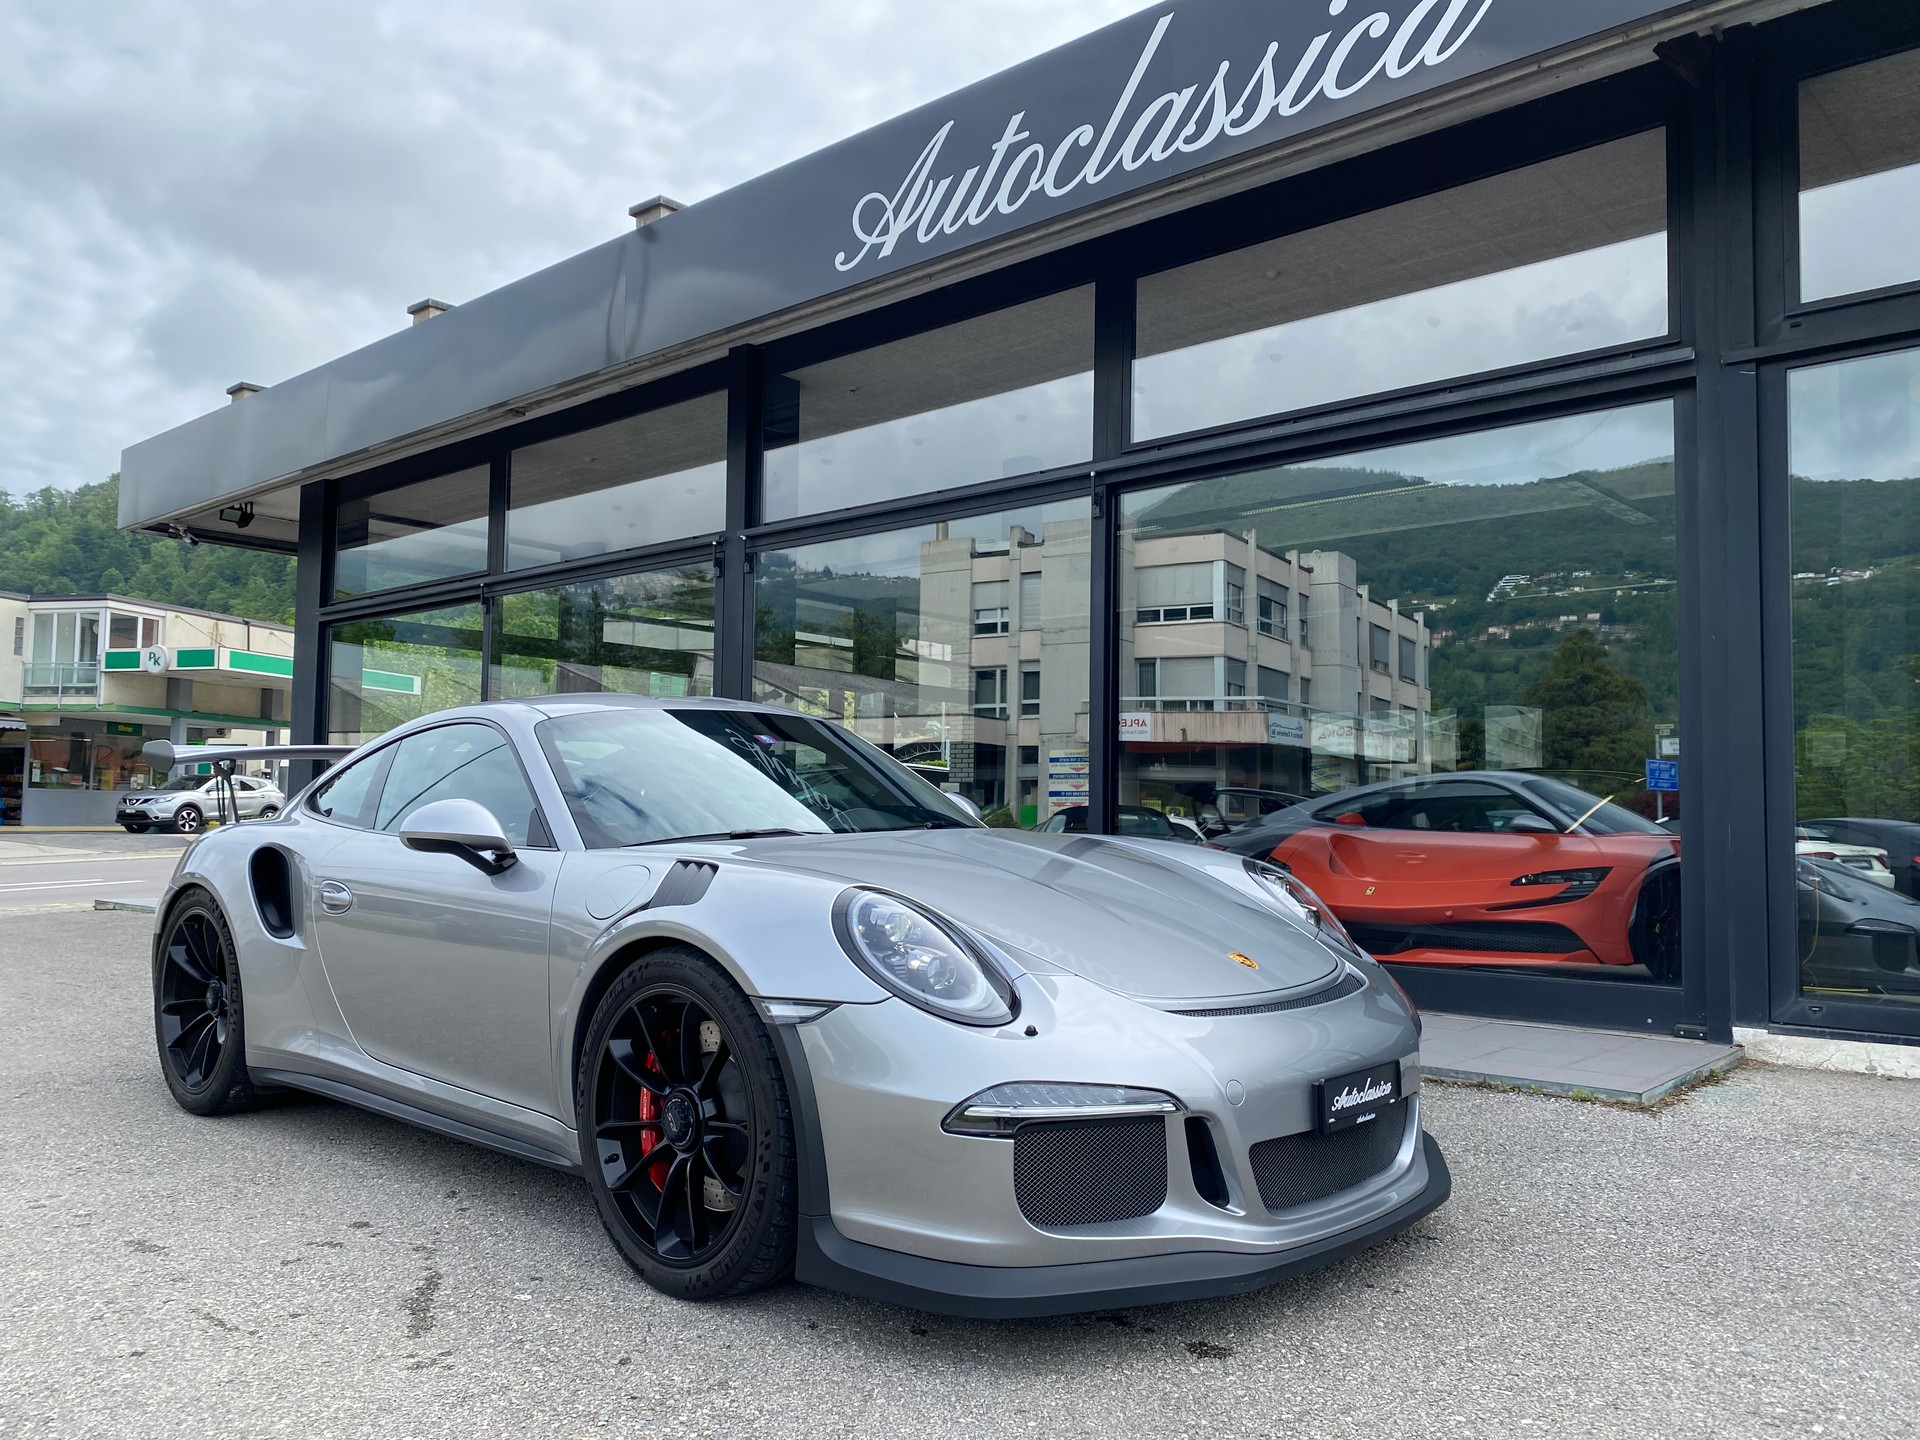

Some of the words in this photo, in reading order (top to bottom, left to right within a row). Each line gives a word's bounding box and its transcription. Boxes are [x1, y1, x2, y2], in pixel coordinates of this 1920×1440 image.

[834, 0, 1492, 272] Autoclassica
[117, 724, 133, 733] Shop
[1331, 1077, 1393, 1112] Autoclassica
[709, 1180, 768, 1281] MICHELIN
